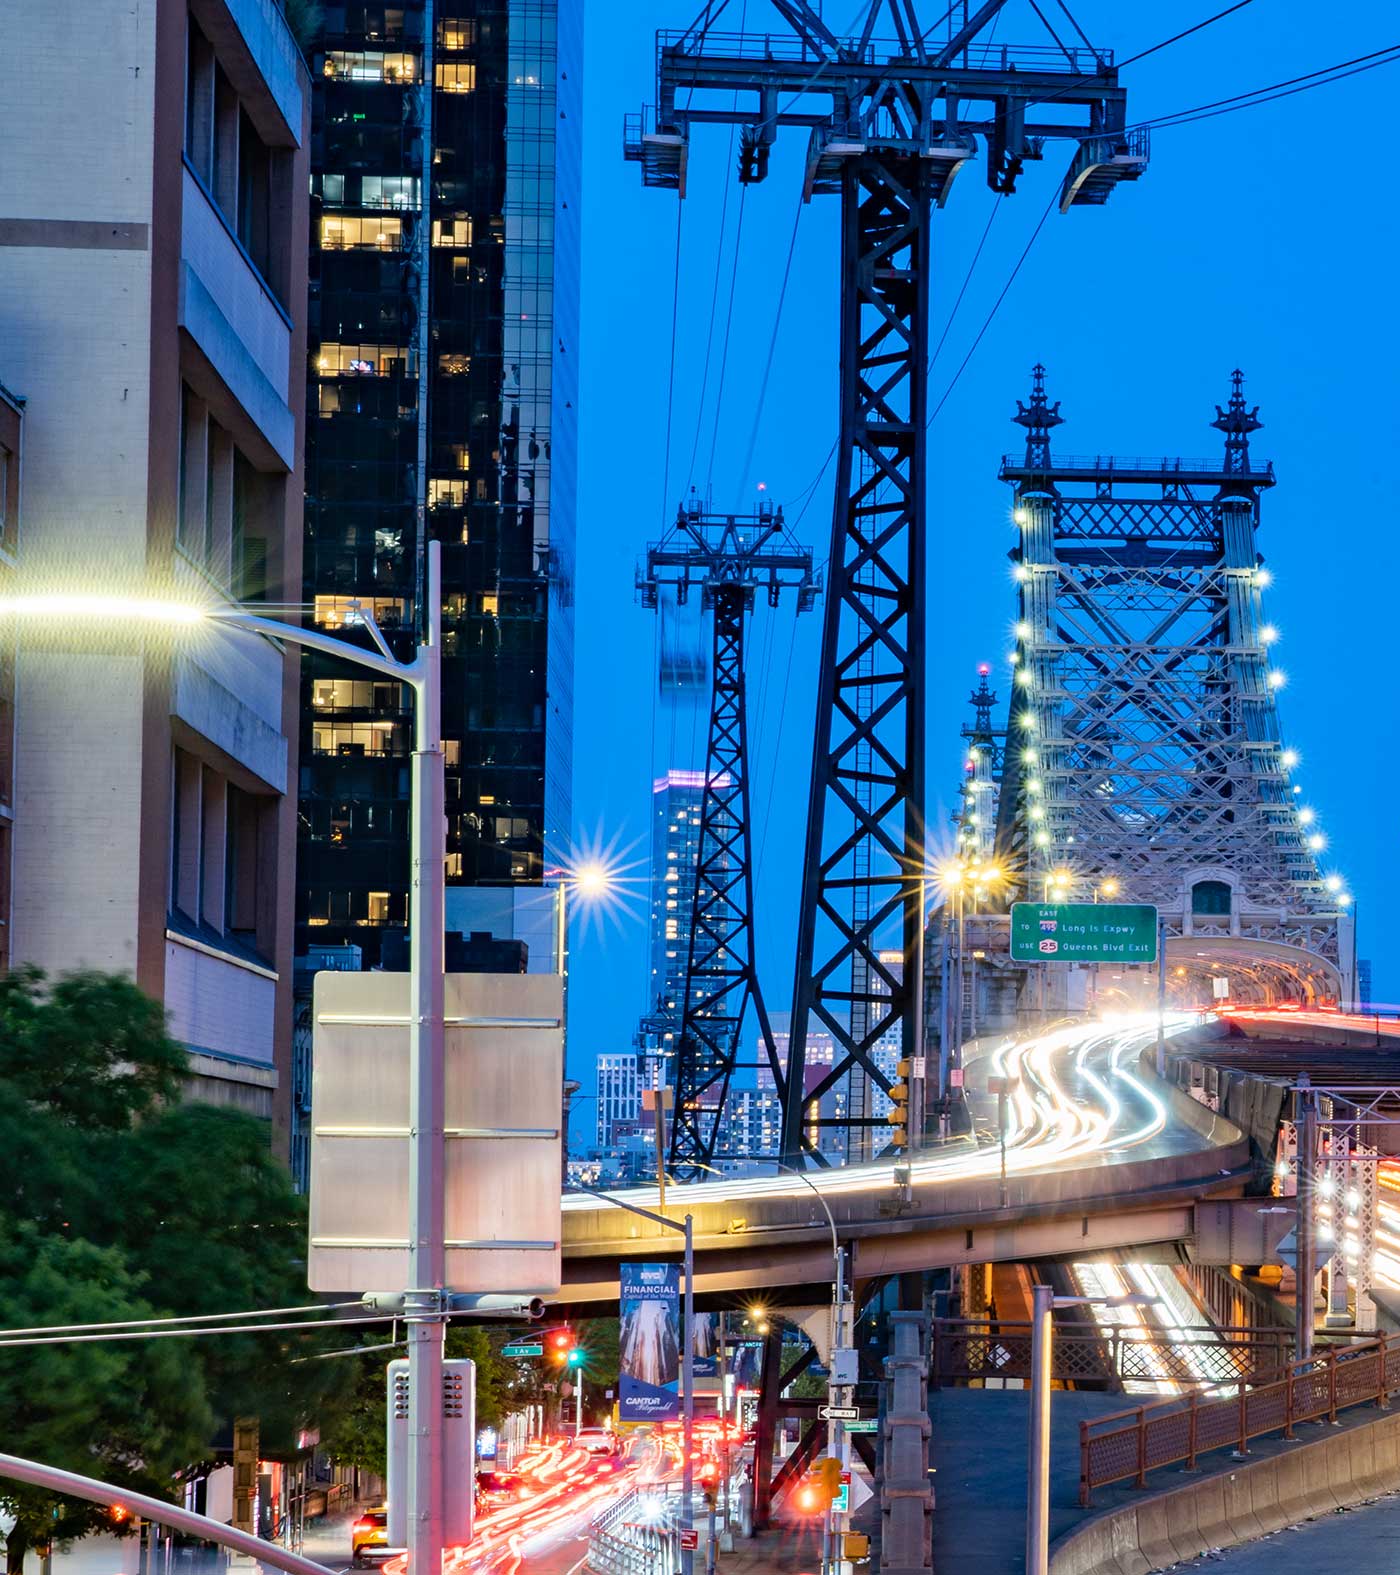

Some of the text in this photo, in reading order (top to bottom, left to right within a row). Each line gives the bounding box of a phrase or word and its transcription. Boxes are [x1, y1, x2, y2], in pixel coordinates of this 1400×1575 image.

[1062, 924, 1086, 934] Long
[1104, 925, 1136, 934] Expwy
[1040, 942, 1057, 951] 25
[636, 1402, 672, 1414] Fitzgerald
